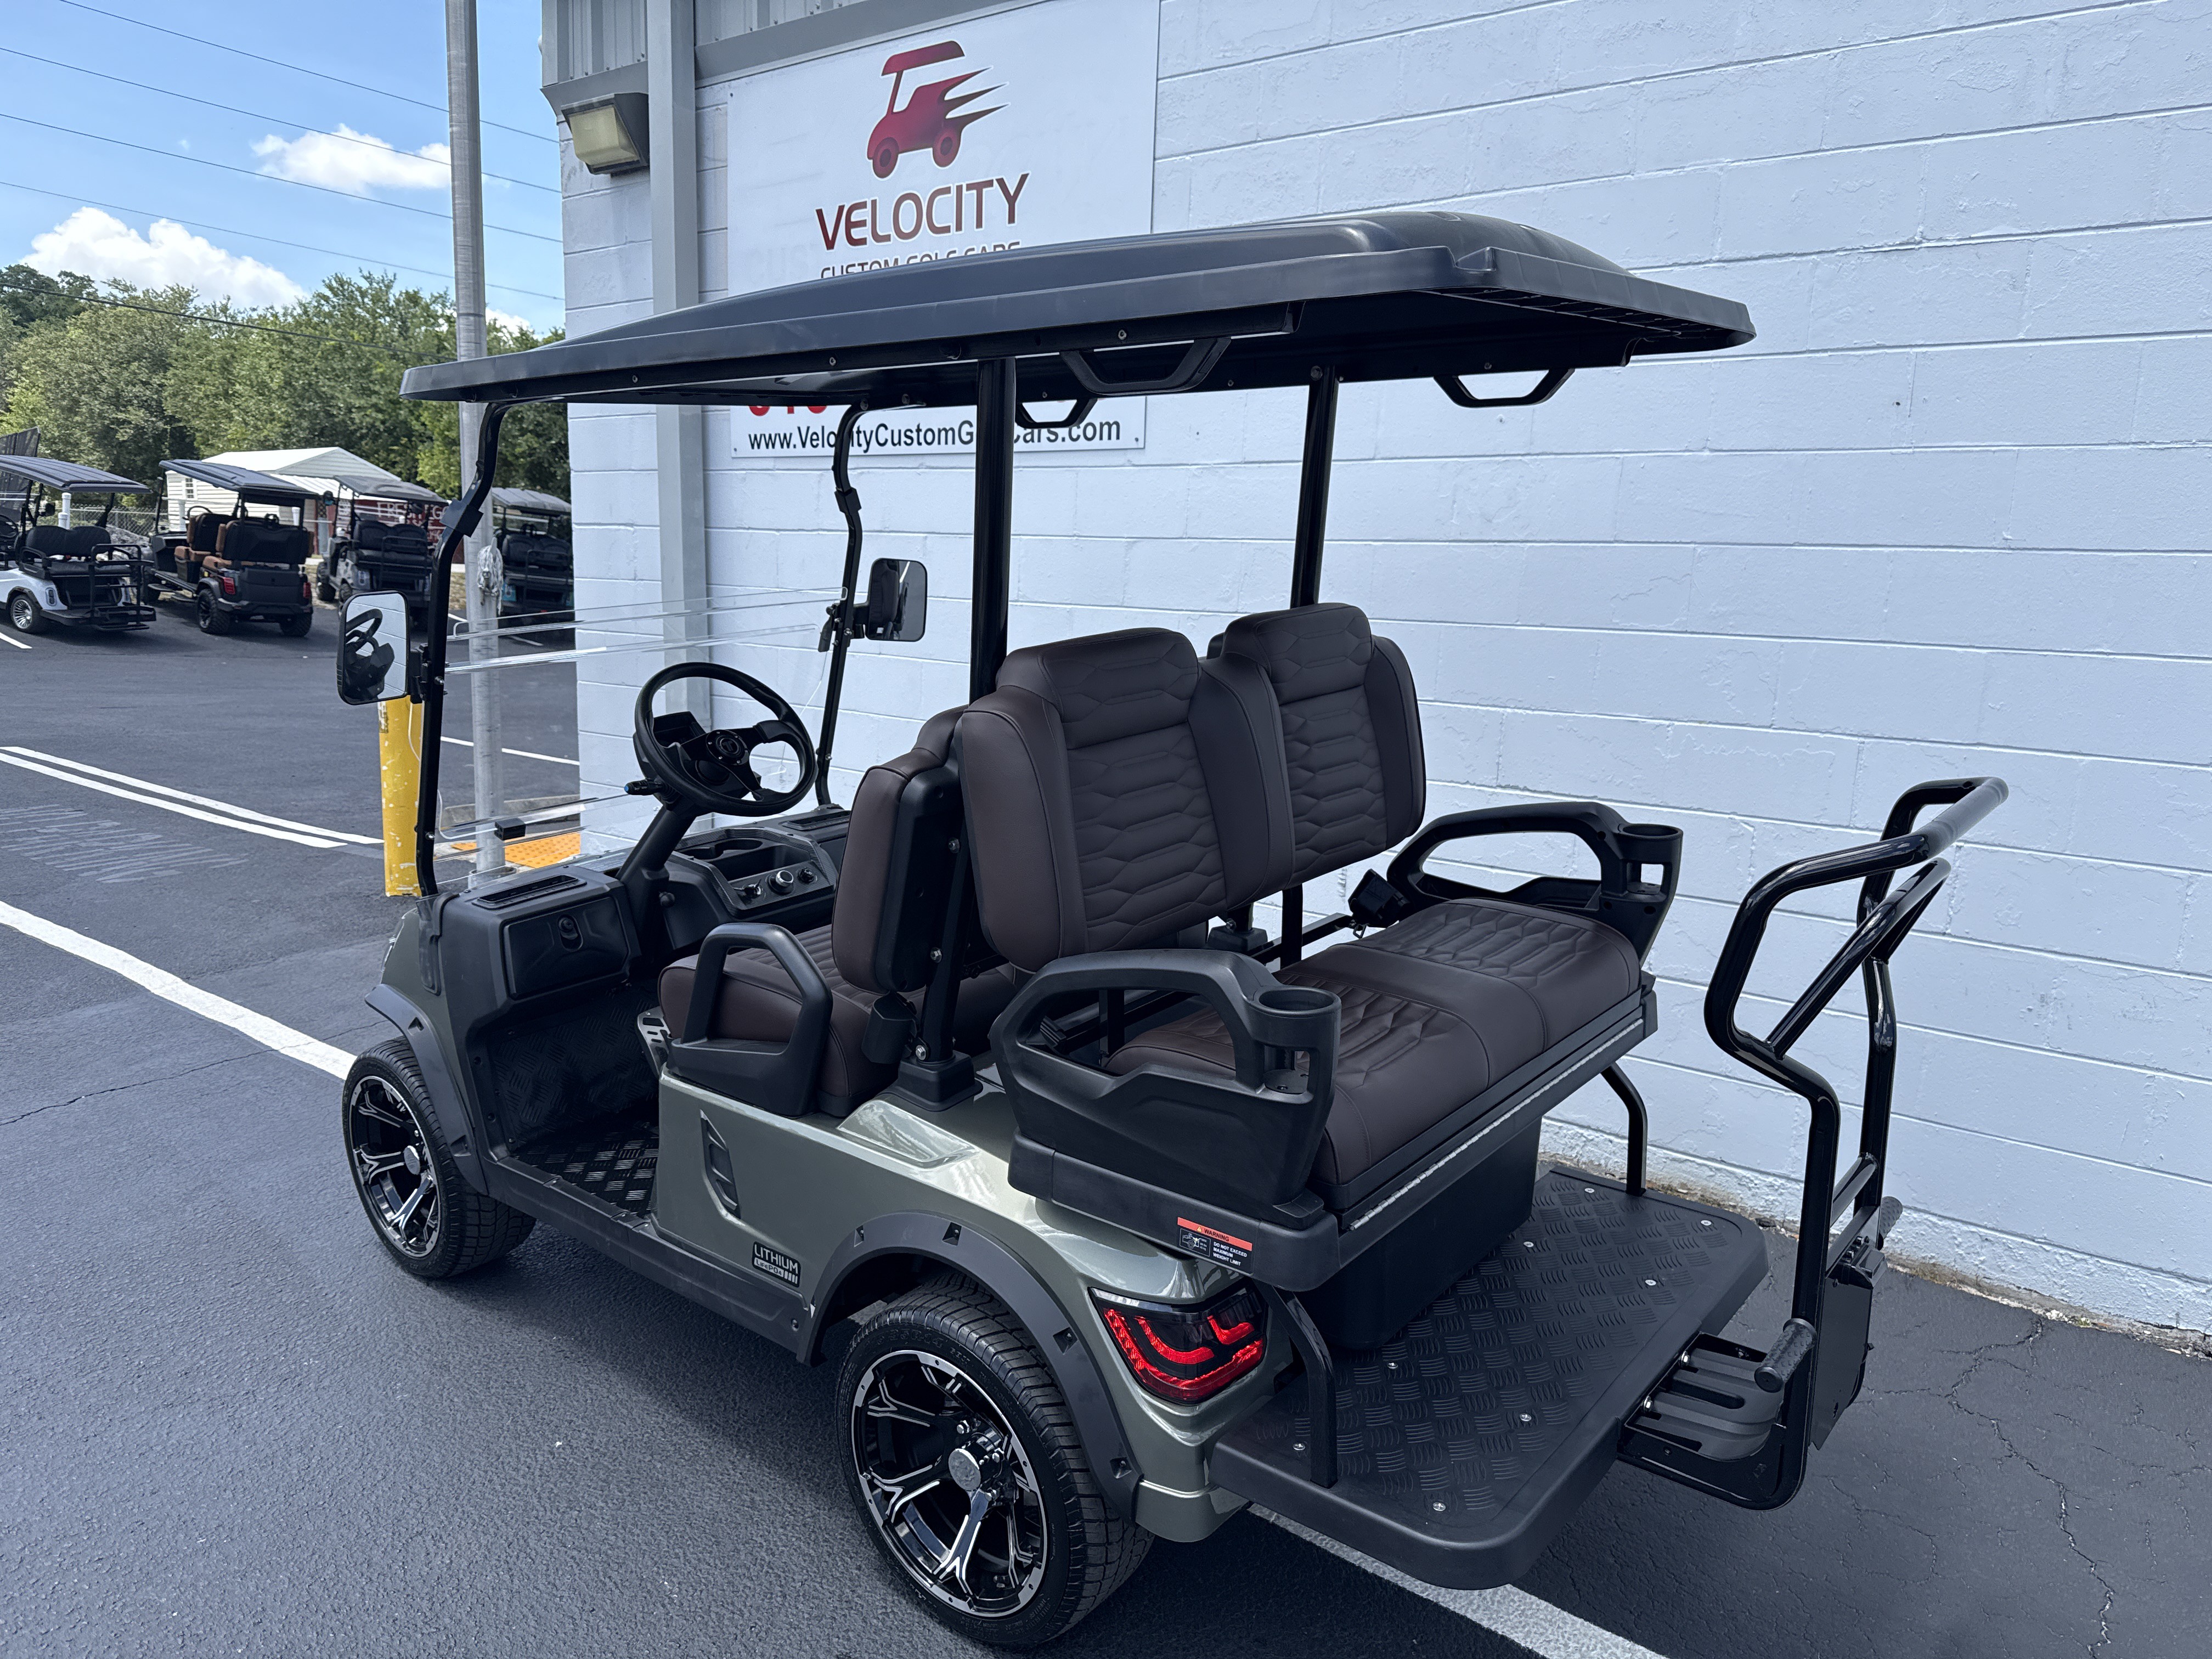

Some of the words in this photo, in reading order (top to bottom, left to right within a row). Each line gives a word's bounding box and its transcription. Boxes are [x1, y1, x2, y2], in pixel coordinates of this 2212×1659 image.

[815, 173, 1030, 251] VELOCITY
[748, 420, 1121, 454] www.VeloityCustomGars.com
[1204, 1228, 1229, 1242] WARNING
[754, 1244, 798, 1274] LITHIUM
[1213, 1252, 1229, 1261] WEIGHT
[1230, 1248, 1247, 1257] EXCEED
